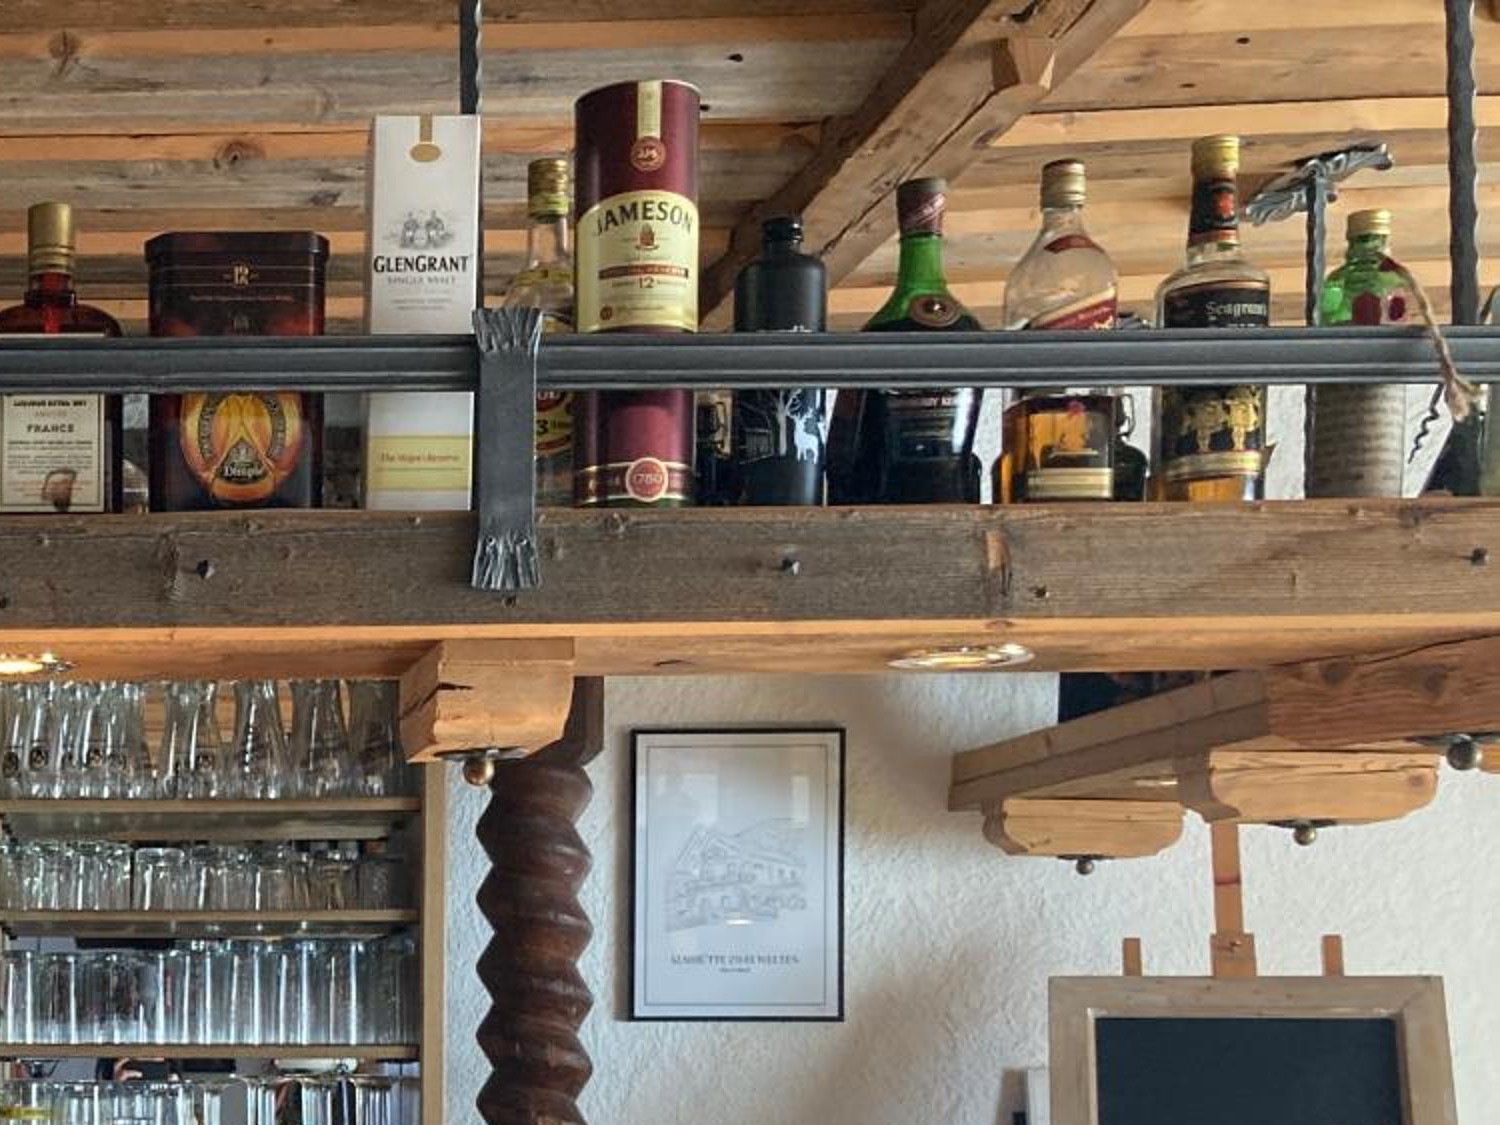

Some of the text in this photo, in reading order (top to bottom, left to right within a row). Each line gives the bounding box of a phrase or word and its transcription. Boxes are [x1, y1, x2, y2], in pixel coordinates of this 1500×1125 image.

[596, 201, 693, 236] JAMESON
[373, 256, 469, 273] GLENGRANT
[638, 276, 655, 289] 12
[27, 423, 74, 433] FRANCE
